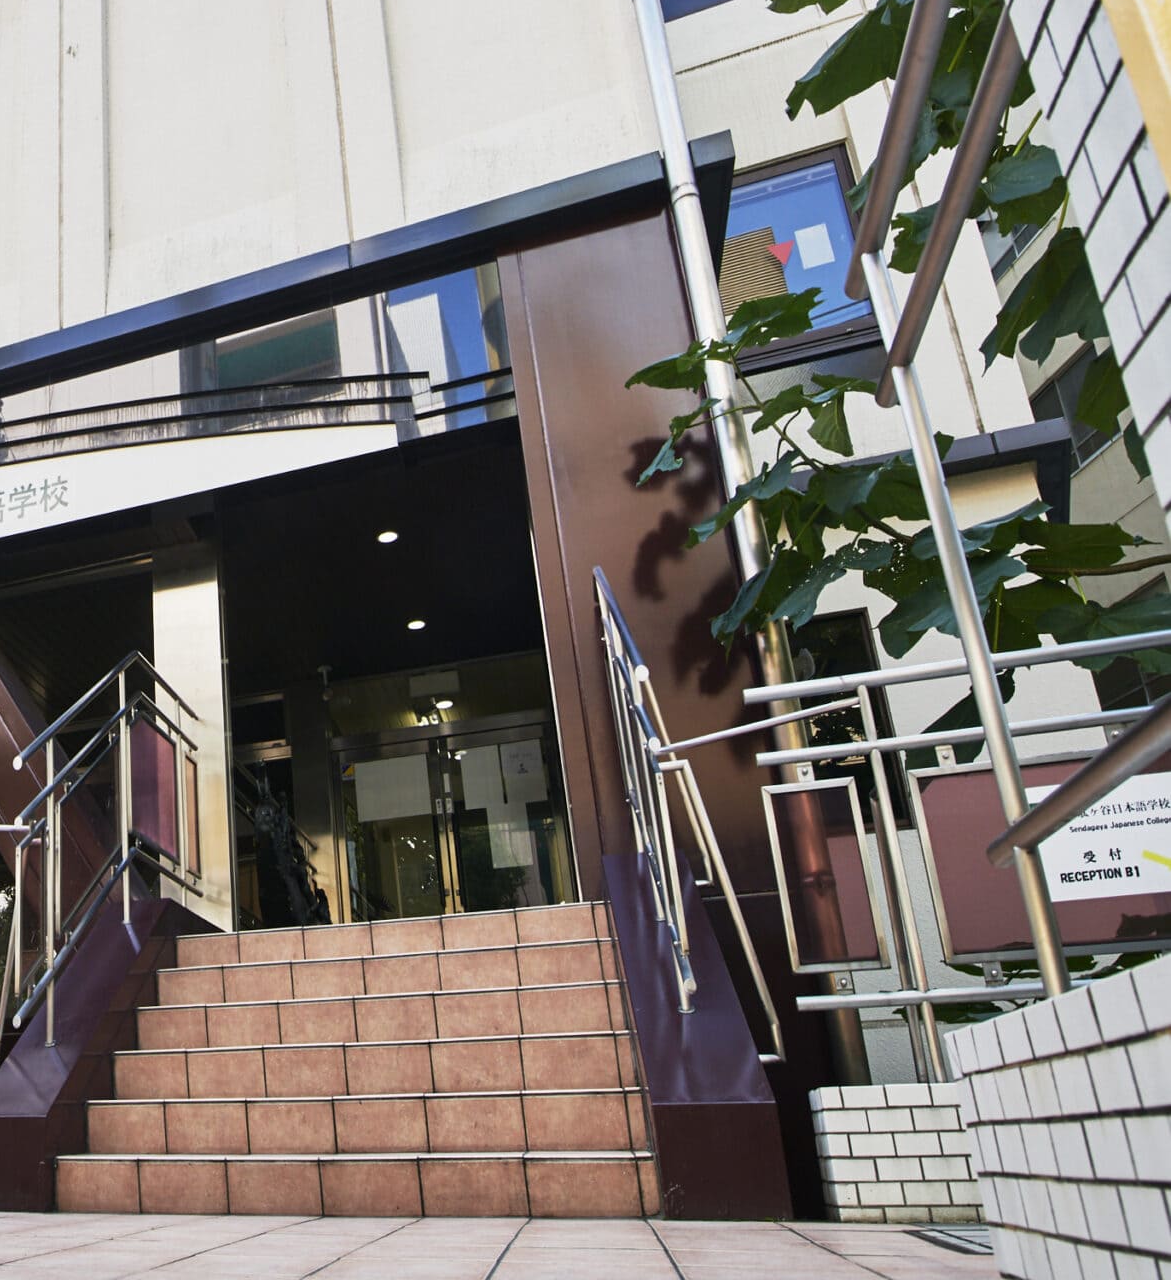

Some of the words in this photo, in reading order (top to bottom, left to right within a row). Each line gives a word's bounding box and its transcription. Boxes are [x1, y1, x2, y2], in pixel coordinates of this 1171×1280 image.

[1069, 824, 1108, 833] Sendagaya
[1110, 820, 1144, 829] Japanese
[1060, 868, 1123, 883] RECEPTION
[1125, 865, 1141, 878] B1
